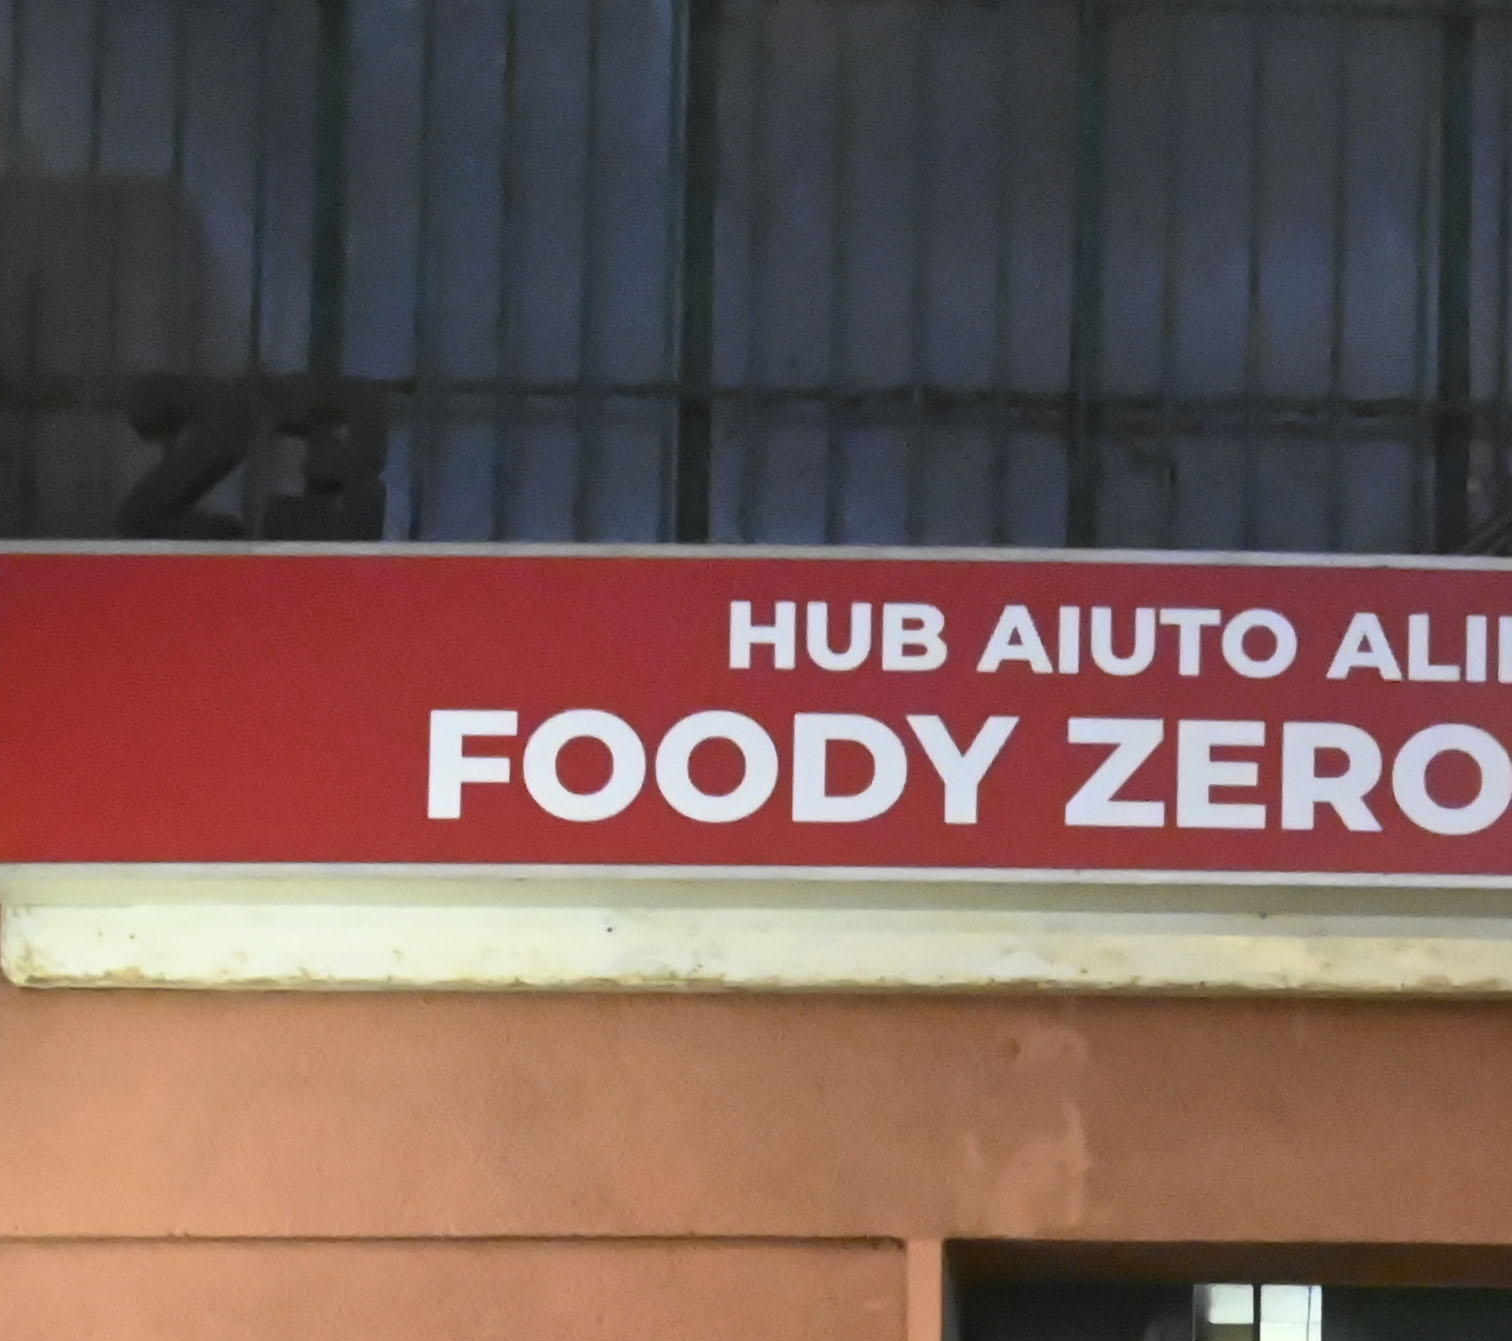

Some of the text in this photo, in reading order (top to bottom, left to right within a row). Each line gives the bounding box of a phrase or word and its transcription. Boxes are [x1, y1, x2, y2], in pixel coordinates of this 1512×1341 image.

[727, 599, 949, 673] HUB
[975, 603, 1299, 680] AIUTO
[425, 708, 1020, 826] FOODY
